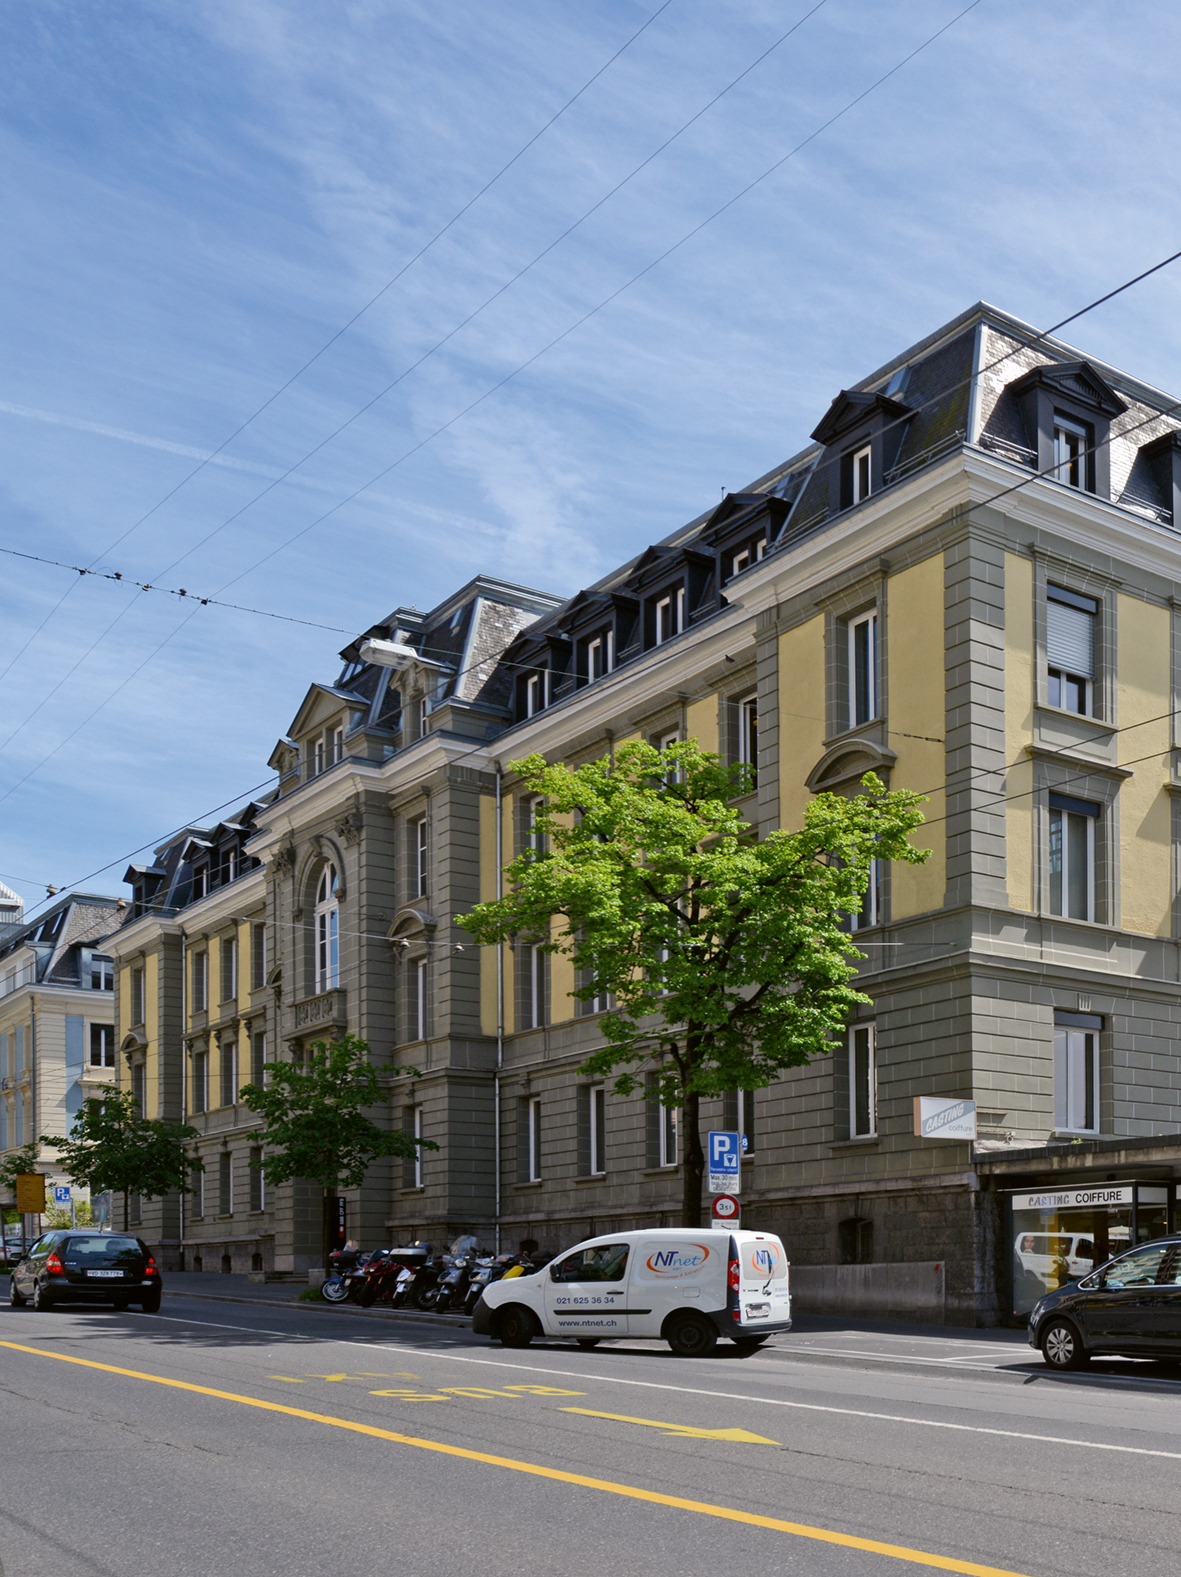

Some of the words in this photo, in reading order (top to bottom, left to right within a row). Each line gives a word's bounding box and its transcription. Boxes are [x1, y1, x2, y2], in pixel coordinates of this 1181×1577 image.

[925, 1103, 965, 1132] CASTING
[949, 1124, 972, 1132] coiffure
[714, 1135, 730, 1161] P
[1028, 1195, 1069, 1206] CASTING
[1075, 1191, 1122, 1203] COIFFURE
[558, 1319, 617, 1327] www.ntnet.ch
